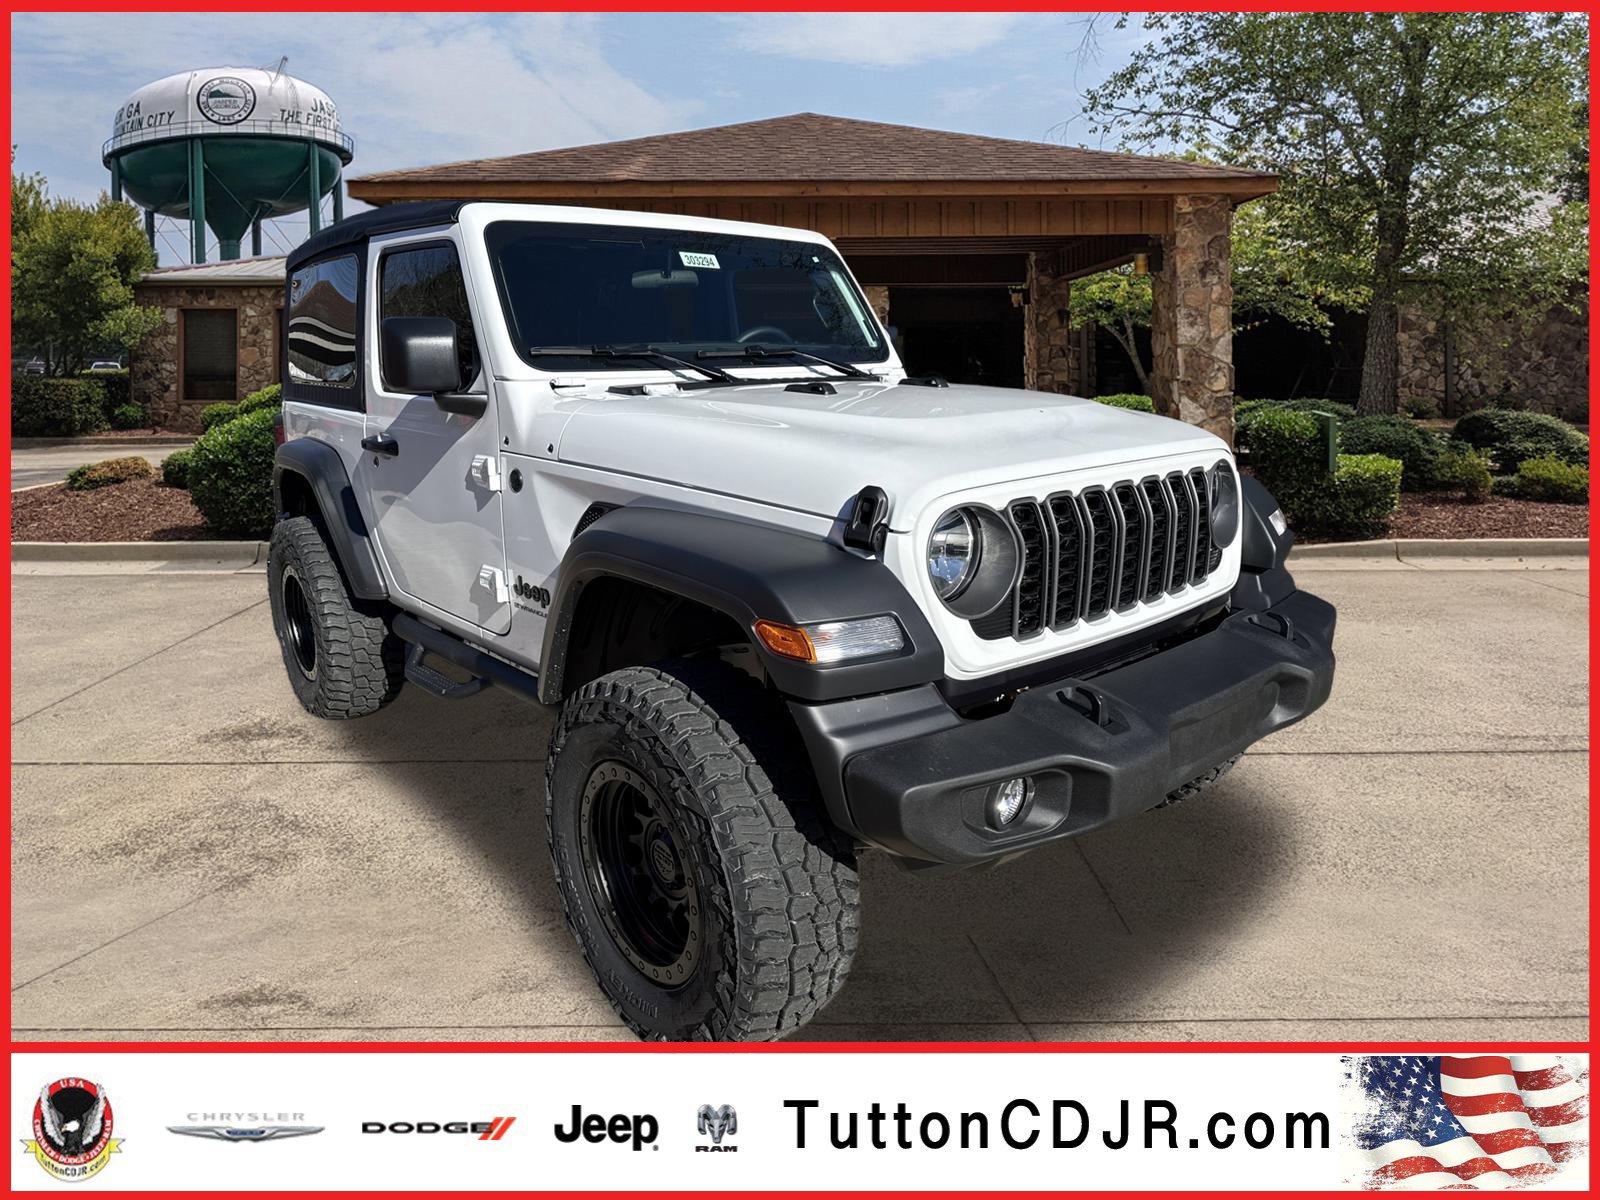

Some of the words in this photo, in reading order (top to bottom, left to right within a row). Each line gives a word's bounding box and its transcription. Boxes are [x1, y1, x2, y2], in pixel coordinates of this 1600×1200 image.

[126, 100, 141, 119] GA
[147, 110, 175, 127] CITY
[280, 108, 302, 124] THE
[306, 112, 332, 129] FIRST
[684, 254, 716, 267] 303294
[513, 575, 551, 609] Jeep
